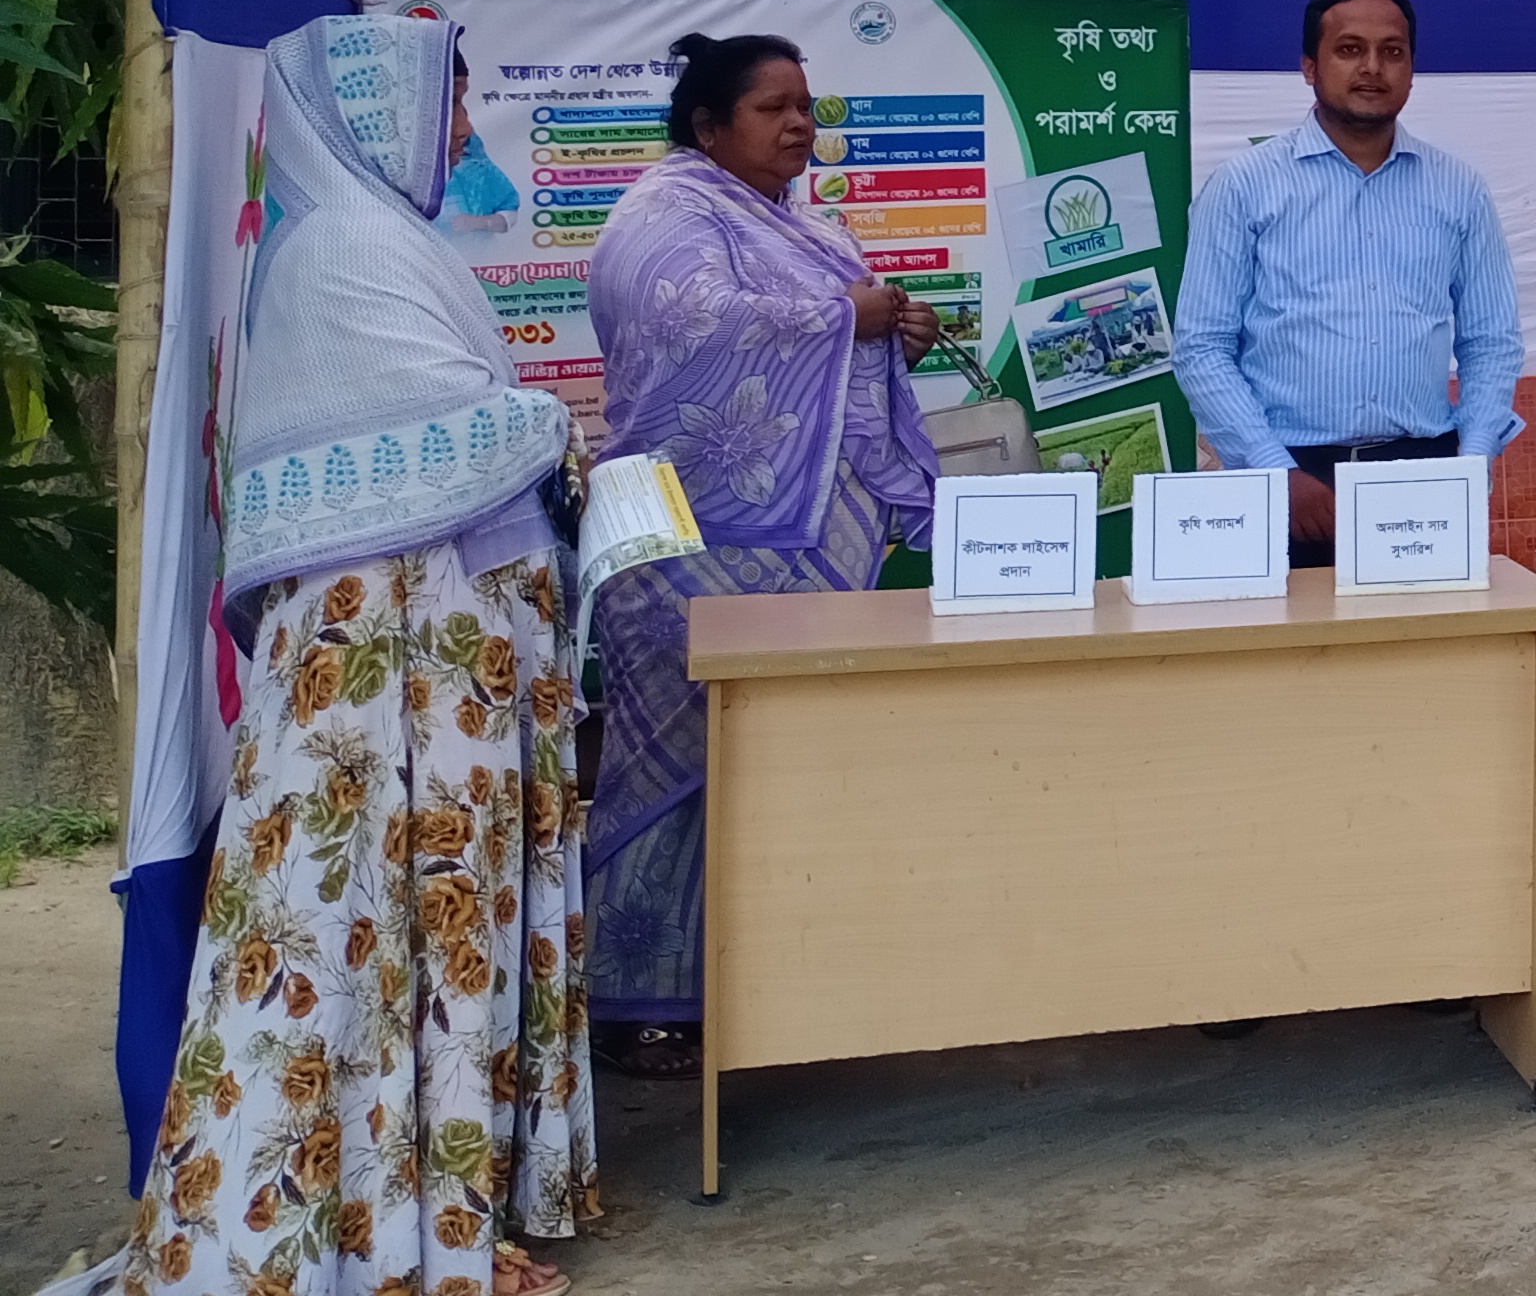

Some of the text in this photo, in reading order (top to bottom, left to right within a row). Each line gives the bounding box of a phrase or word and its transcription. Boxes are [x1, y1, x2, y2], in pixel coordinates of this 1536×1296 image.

[1054, 19, 1157, 62] কৃষি তথ্য
[570, 65, 602, 79] দেশ
[607, 63, 644, 79] থেকে
[1097, 71, 1117, 91] ও
[852, 99, 873, 111] ধান
[1035, 102, 1180, 138] পরামর্শ কেন্দ্র
[852, 138, 870, 149] গম
[1177, 513, 1244, 532] কৃষি পরামর্শ
[1376, 519, 1448, 533] অনলাইন সার
[961, 540, 1018, 555] কীটনাশক
[1390, 541, 1433, 559] সুপারিশ
[999, 566, 1032, 578] প্রদান
